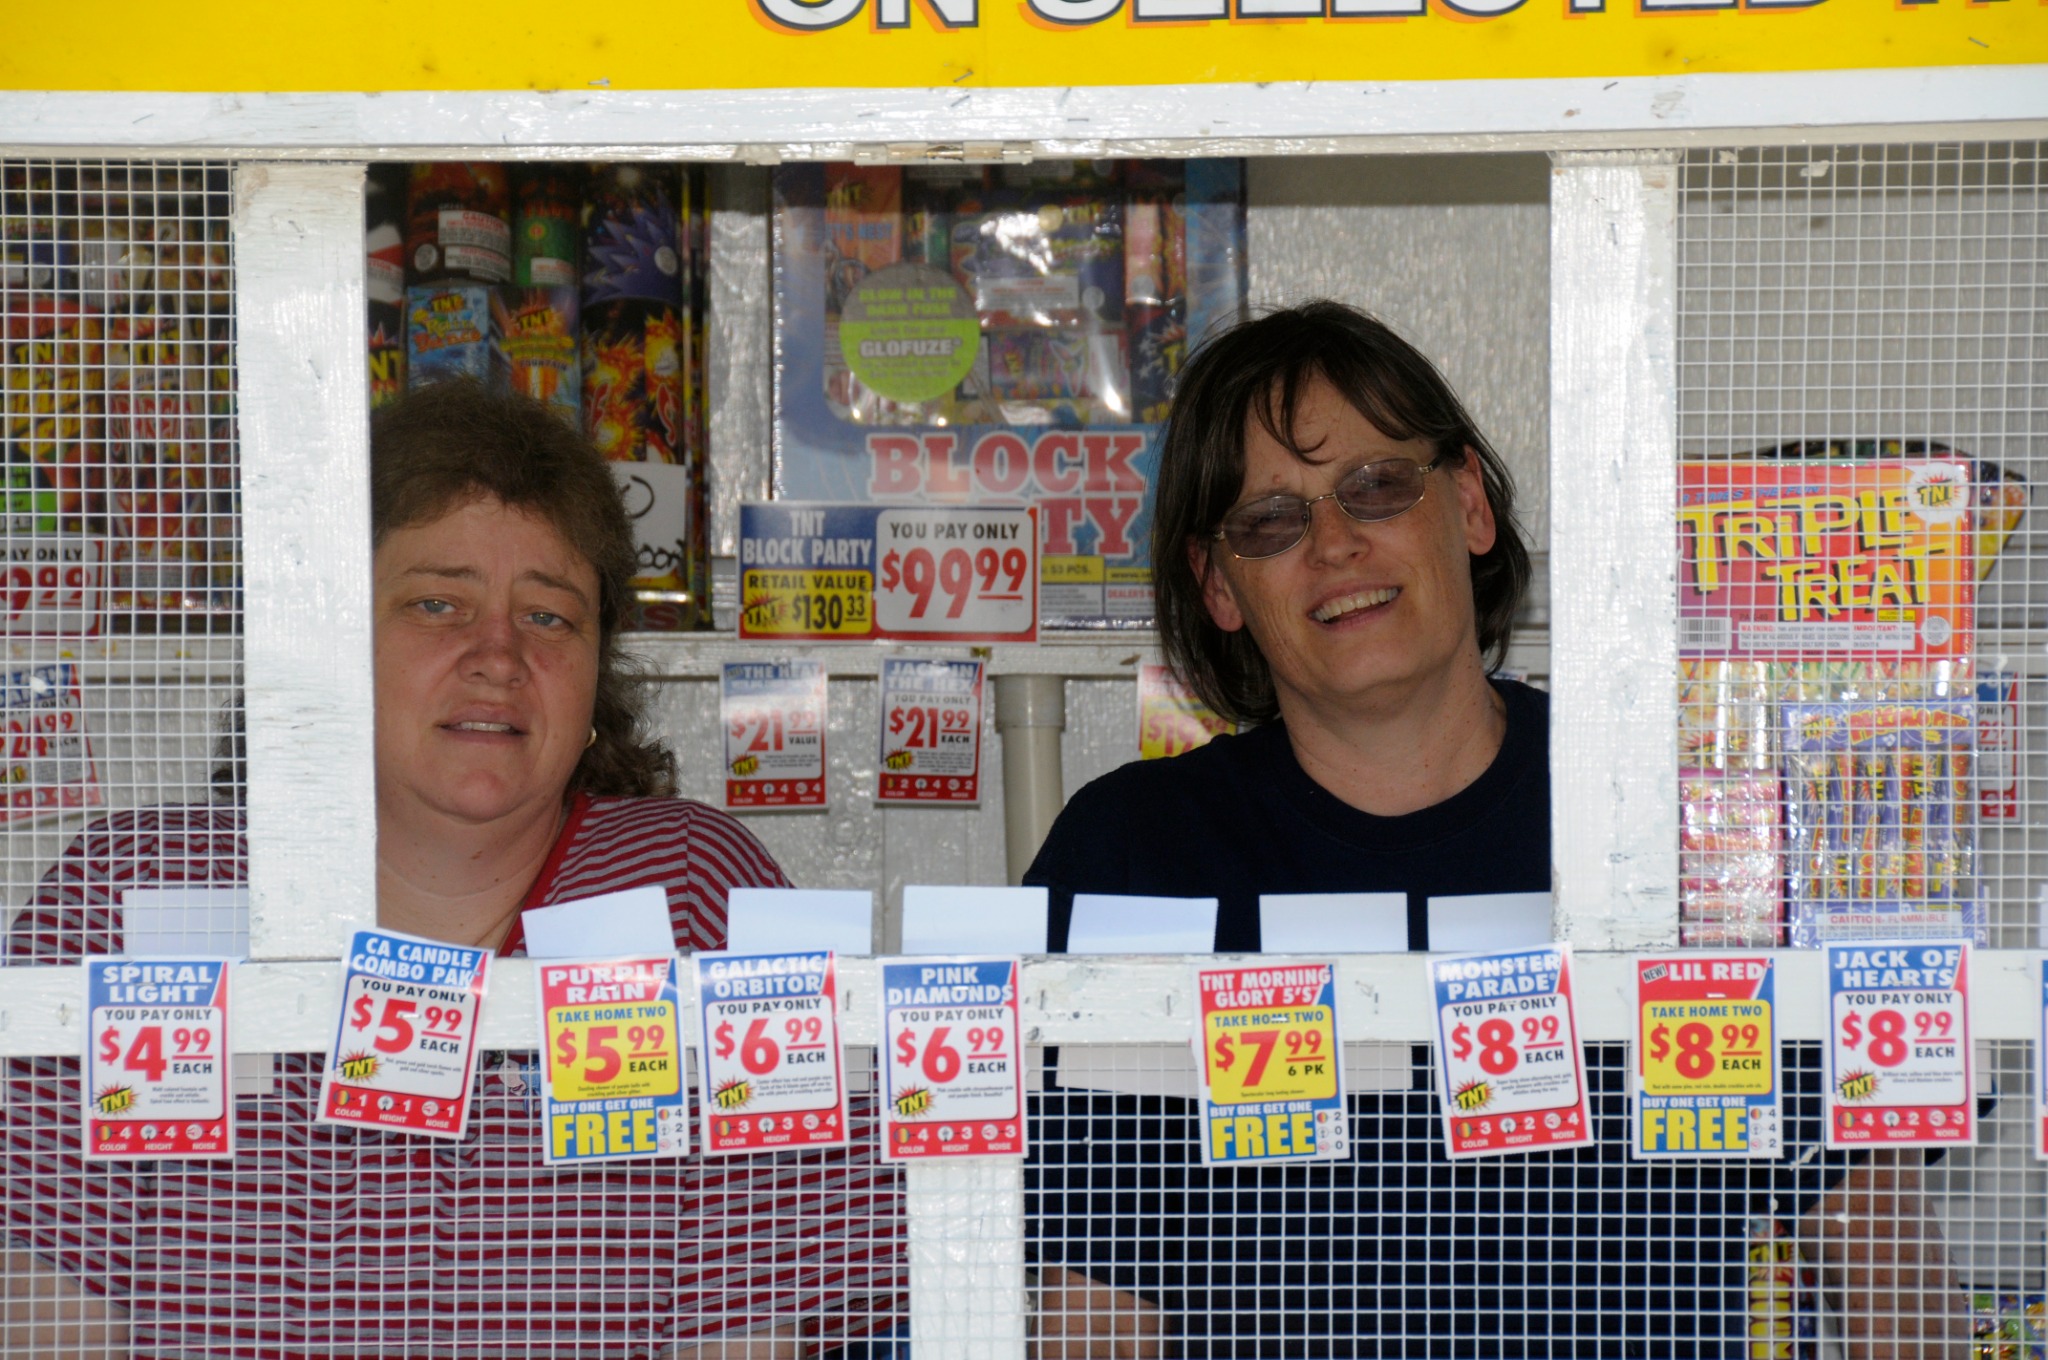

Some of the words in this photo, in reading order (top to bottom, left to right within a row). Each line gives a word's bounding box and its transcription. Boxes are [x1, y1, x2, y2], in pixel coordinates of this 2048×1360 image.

[860, 339, 953, 357] GLOFUZE
[868, 432, 1146, 494] BLOCK
[789, 510, 826, 537] TNT
[889, 523, 927, 539] YOU
[934, 523, 969, 539] PAY
[973, 523, 1020, 539] ONLY
[1677, 490, 1921, 591] TRIPLE
[742, 538, 805, 565] BLOCK
[811, 538, 873, 566] PARTY
[748, 574, 807, 590] RETAIL
[812, 574, 868, 590] VALUE
[1766, 542, 1951, 621] TREAT
[943, 696, 971, 705] ONLY
[789, 736, 817, 745] VALUE
[941, 735, 970, 743] EACH
[366, 937, 391, 958] CA
[397, 944, 473, 968] CANDLE
[1835, 950, 1910, 969] JACK
[1921, 949, 1960, 967] OF
[103, 966, 213, 983] SPIRAL
[352, 954, 425, 980] COMBO
[431, 966, 474, 987] PAK
[547, 962, 669, 987] PURPLE
[709, 954, 824, 980] GALACTIC
[921, 966, 979, 985] PINK
[1438, 953, 1562, 983] MONSTER
[1642, 964, 1667, 982] NEW!
[1668, 963, 1706, 981] LIL
[1711, 962, 1764, 980] RED
[714, 974, 821, 998] ORBITOR
[1200, 973, 1235, 992] TNT
[1241, 967, 1332, 989] MORNING
[1447, 973, 1550, 1001] PARADE
[1842, 968, 1954, 988] HEARTS
[109, 985, 199, 1003] LIGHT
[362, 978, 392, 993] YOU
[396, 984, 426, 998] PAY
[428, 989, 467, 1003] ONLY
[566, 982, 646, 1004] RAIN
[887, 984, 1015, 1006] DIAMONDS
[1214, 989, 1276, 1009] GLORY
[1845, 994, 1876, 1005] YOU
[1881, 993, 1911, 1005] PAY
[1914, 992, 1953, 1004] ONLY
[104, 1009, 135, 1021] YOU
[141, 1009, 170, 1021] PAY
[173, 1009, 212, 1021] ONLY
[556, 1010, 590, 1023] TAKE
[594, 1008, 633, 1021] HOME
[637, 1006, 667, 1018] TWO
[717, 1003, 747, 1015] YOU
[752, 1000, 781, 1013] PAY
[784, 998, 822, 1011] ONLY
[900, 1011, 930, 1022] YOU
[935, 1009, 964, 1021] PAY
[967, 1008, 1004, 1020] ONLY
[1452, 1003, 1483, 1018] YOU
[1488, 1001, 1516, 1014] PAY
[1519, 996, 1557, 1011] ONLY
[1651, 1006, 1685, 1018] TAKE
[1689, 1006, 1728, 1017] HOME
[1732, 1005, 1763, 1016] TWO
[1214, 1015, 1248, 1028] TAKE
[1252, 1012, 1291, 1025] HOME
[1294, 1010, 1324, 1023] TWO
[420, 1038, 459, 1054] EACH
[1915, 1047, 1955, 1058] EACH
[629, 1060, 668, 1072] EACH
[787, 1051, 826, 1064] EACH
[1525, 1050, 1564, 1064] EACH
[1722, 1059, 1761, 1070] EACH
[173, 1063, 212, 1074] EACH
[343, 1056, 376, 1080] TNT
[968, 1061, 1006, 1073] EACH
[1287, 1066, 1297, 1076] 6
[1304, 1064, 1324, 1075] PK
[718, 1082, 749, 1109] TNT
[1842, 1073, 1874, 1100] TNT
[99, 1087, 133, 1114] TNT
[898, 1089, 929, 1116] TNT
[1457, 1082, 1488, 1110] TNT
[1642, 1097, 1668, 1108] BUY
[1669, 1097, 1694, 1107] ONE
[1696, 1096, 1720, 1107] GET
[1721, 1096, 1746, 1107] ONE
[551, 1103, 576, 1115] BUY
[578, 1101, 603, 1113] ONE
[605, 1099, 628, 1111] GET
[630, 1098, 654, 1110] ONE
[1209, 1105, 1235, 1118] BUY
[1237, 1104, 1261, 1116] ONE
[1263, 1102, 1287, 1114] GET
[1288, 1101, 1312, 1112] ONE
[334, 1107, 362, 1118] COLOR
[379, 1114, 407, 1124] HEIGHT
[425, 1119, 449, 1129] NOISE
[551, 1109, 657, 1158] FREE
[1210, 1112, 1316, 1160] FREE
[1642, 1108, 1747, 1151] FREE
[1842, 1130, 1870, 1139] COLOR
[1887, 1129, 1916, 1138] HEIGHT
[1935, 1128, 1960, 1138] NOISE
[99, 1143, 127, 1151] COLOR
[144, 1143, 173, 1151] HEIGHT
[192, 1142, 217, 1150] NOISE
[719, 1137, 747, 1147] COLOR
[763, 1134, 791, 1144] HEIGHT
[809, 1131, 834, 1141] NOISE
[897, 1145, 926, 1154] COLOR
[942, 1144, 970, 1152] HEIGHT
[988, 1142, 1012, 1151] NOISE
[1461, 1138, 1489, 1148] COLOR
[1505, 1134, 1533, 1144] HEIGHT
[1551, 1130, 1576, 1140] NOISE
